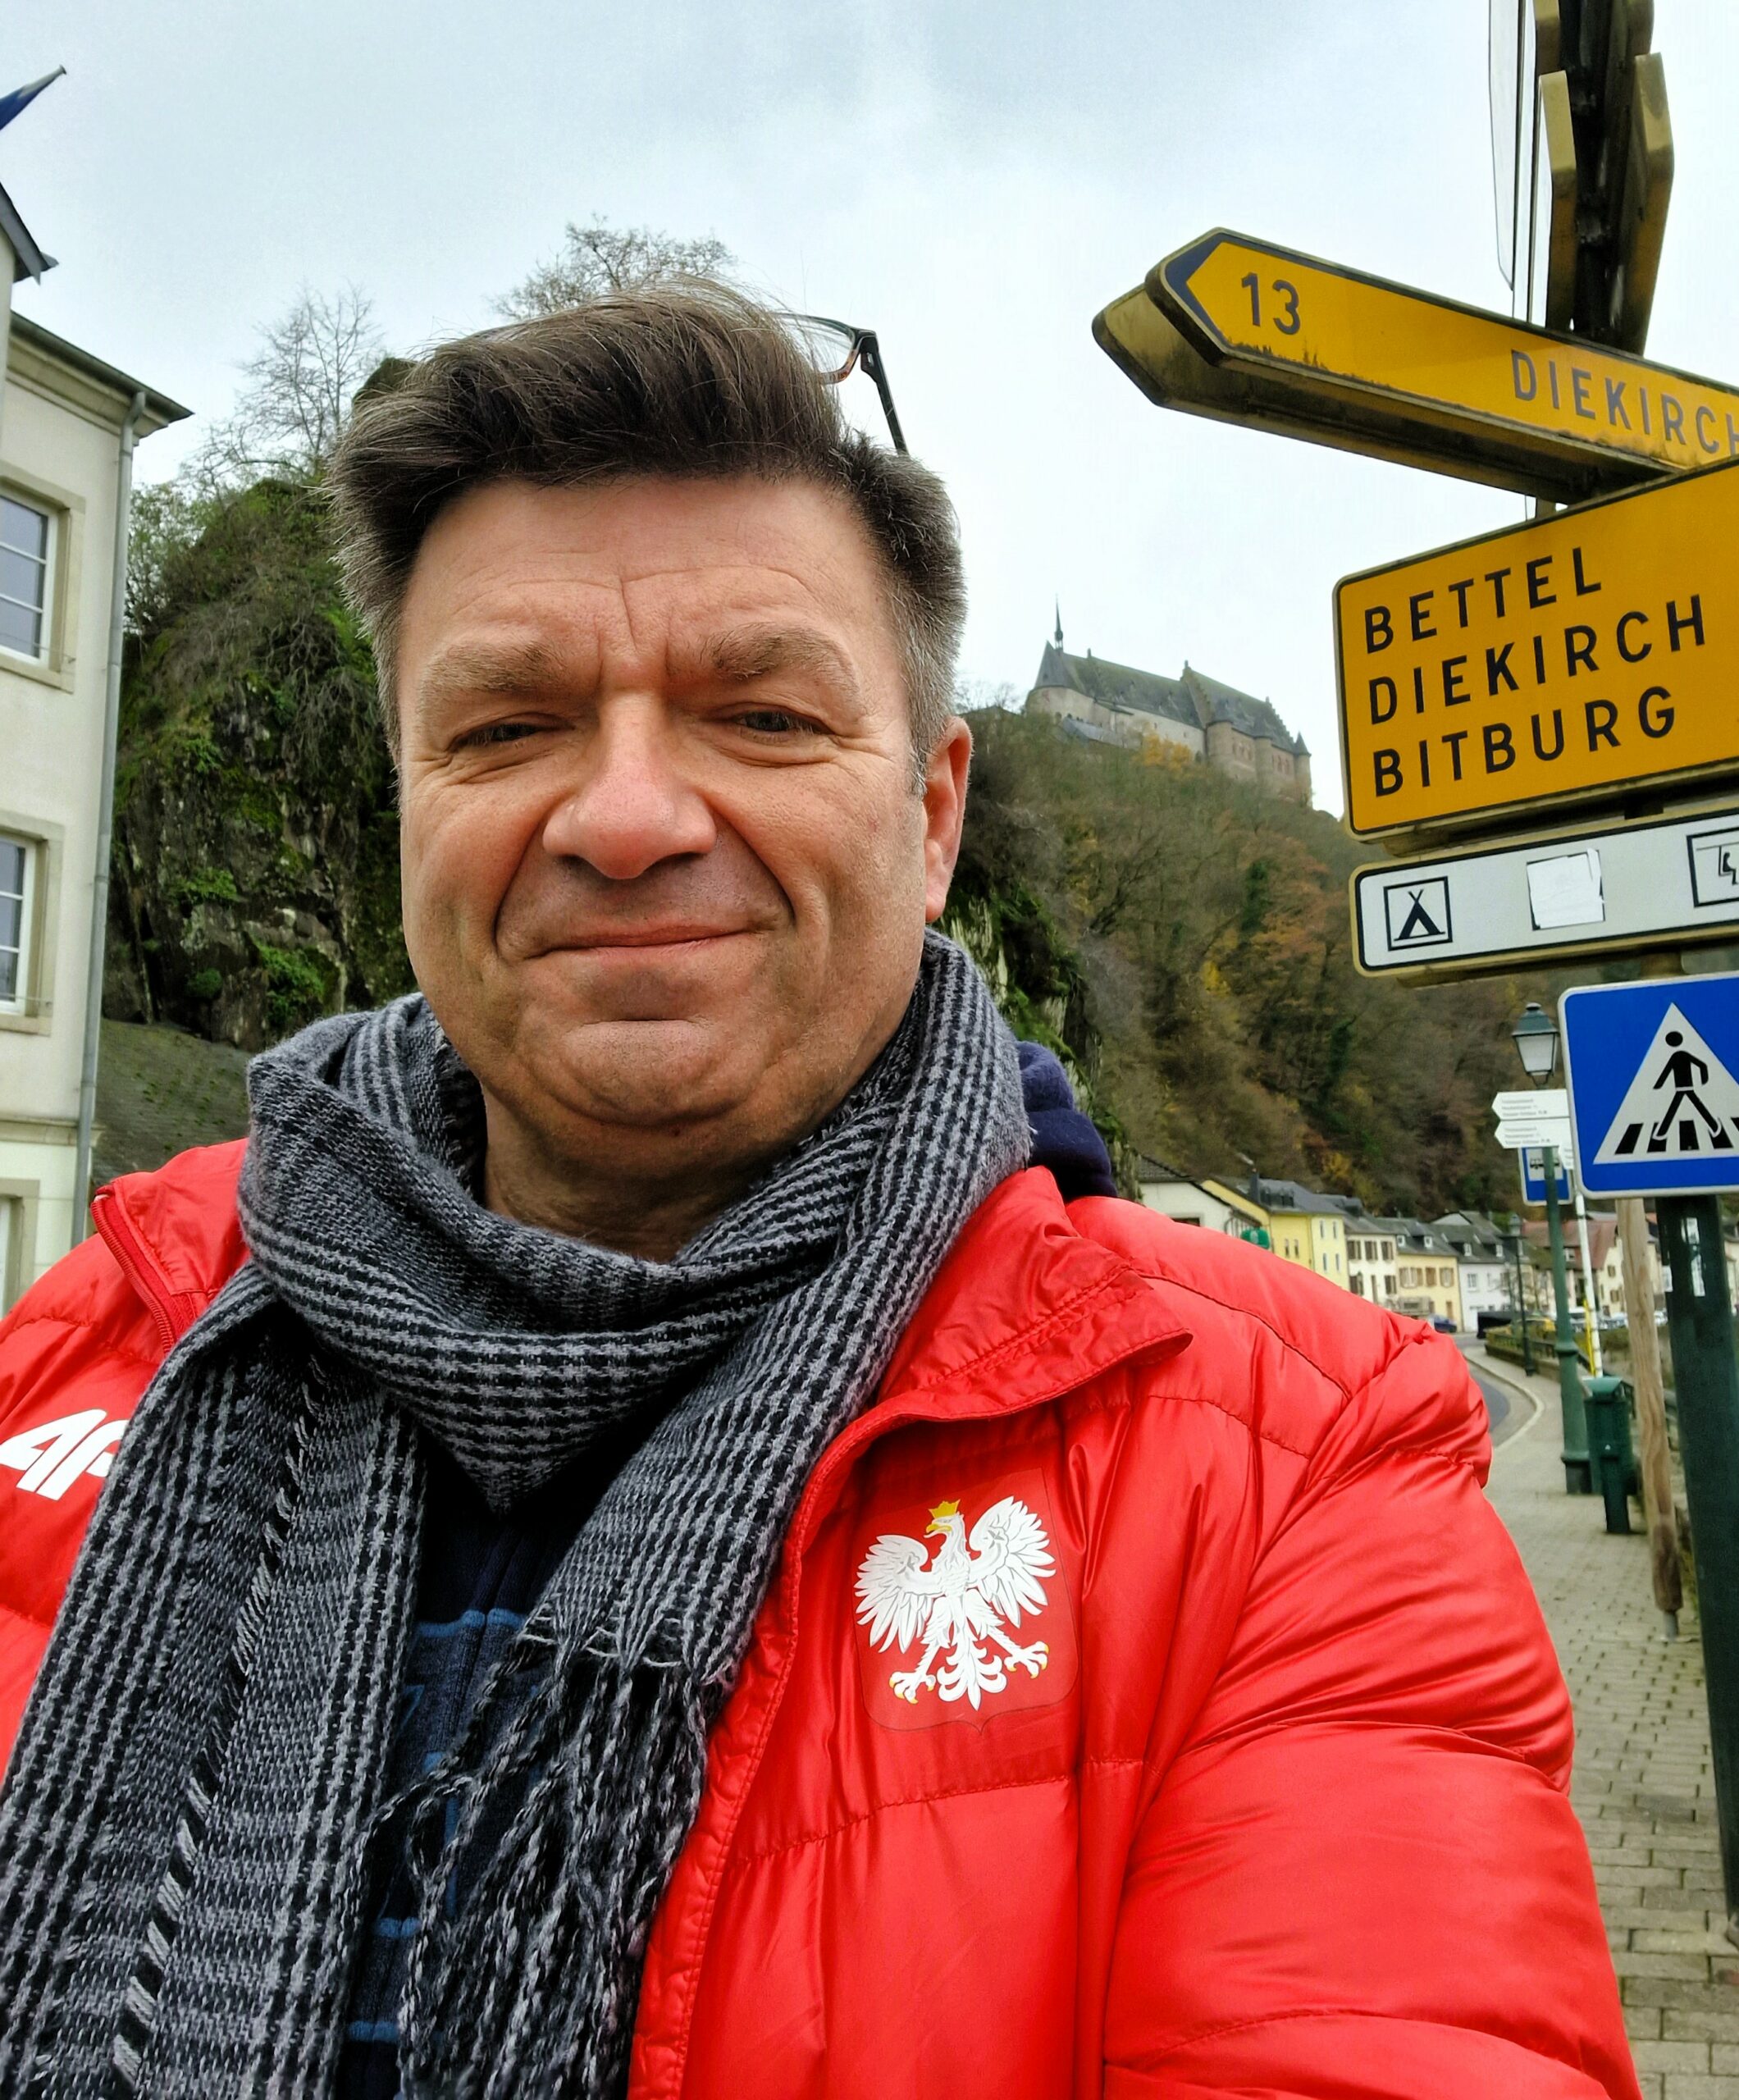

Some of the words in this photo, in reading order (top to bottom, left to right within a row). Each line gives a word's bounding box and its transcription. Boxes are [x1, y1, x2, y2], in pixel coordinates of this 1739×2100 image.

[1240, 272, 1301, 336] 13
[1364, 547, 1601, 655] BETTEL
[1369, 594, 1705, 726] DIEKIRCH
[1373, 686, 1675, 798] BITBURG
